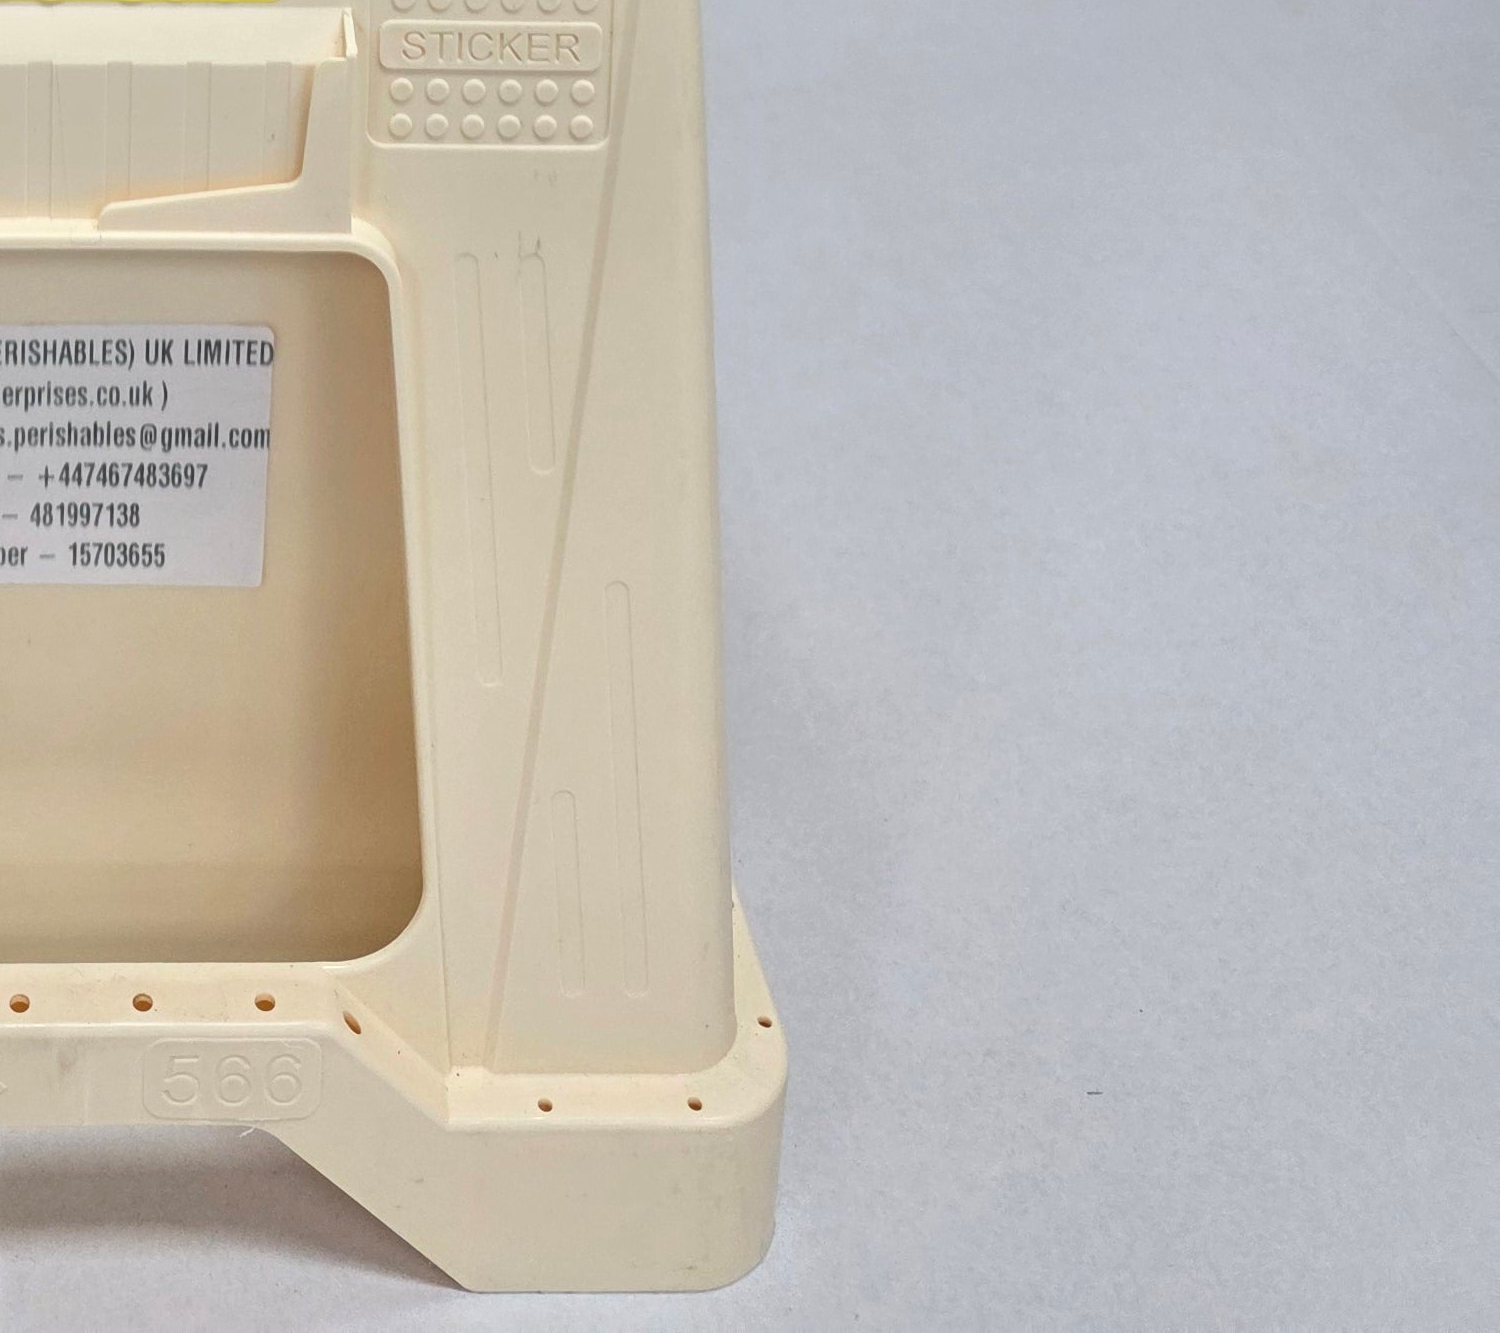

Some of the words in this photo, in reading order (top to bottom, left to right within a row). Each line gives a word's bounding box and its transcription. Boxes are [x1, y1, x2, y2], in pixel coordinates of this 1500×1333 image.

[401, 30, 581, 63] STICKER
[145, 338, 174, 366] UK
[184, 339, 274, 366] LIMITED
[39, 462, 208, 488] +447467483697
[30, 502, 140, 528] 481997138
[69, 542, 165, 568] 15703655
[161, 1054, 303, 1108] 566
